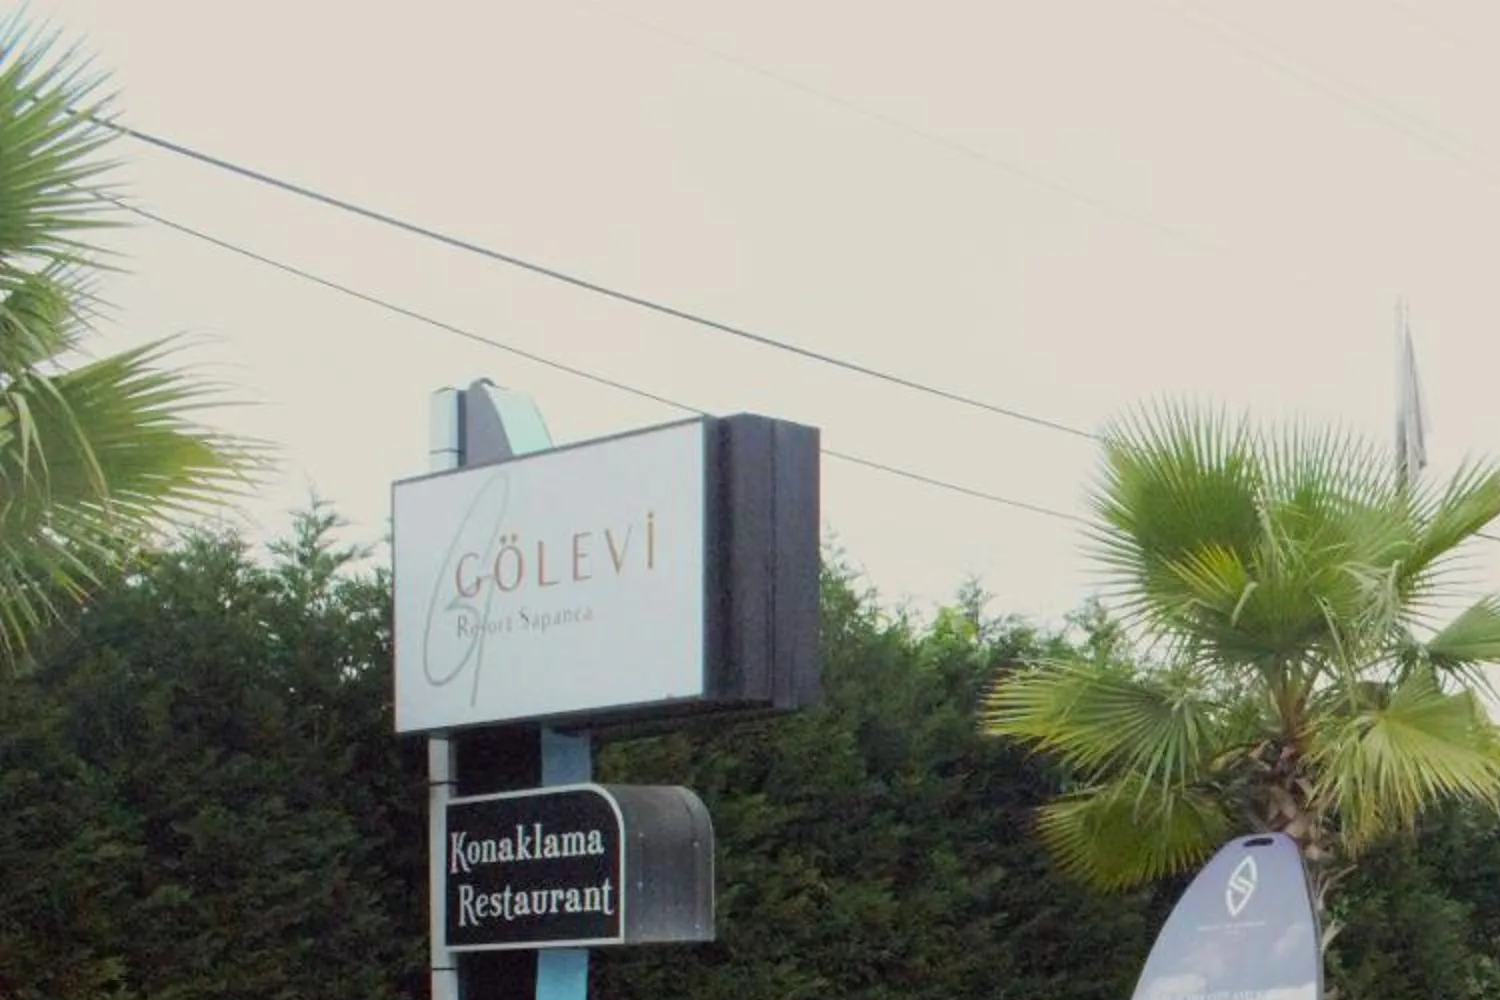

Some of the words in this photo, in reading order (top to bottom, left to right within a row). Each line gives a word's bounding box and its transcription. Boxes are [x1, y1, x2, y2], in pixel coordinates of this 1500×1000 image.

[455, 511, 656, 599] GÖLEVİ
[450, 823, 604, 874] Konaklama
[458, 878, 614, 927] Restaurant
